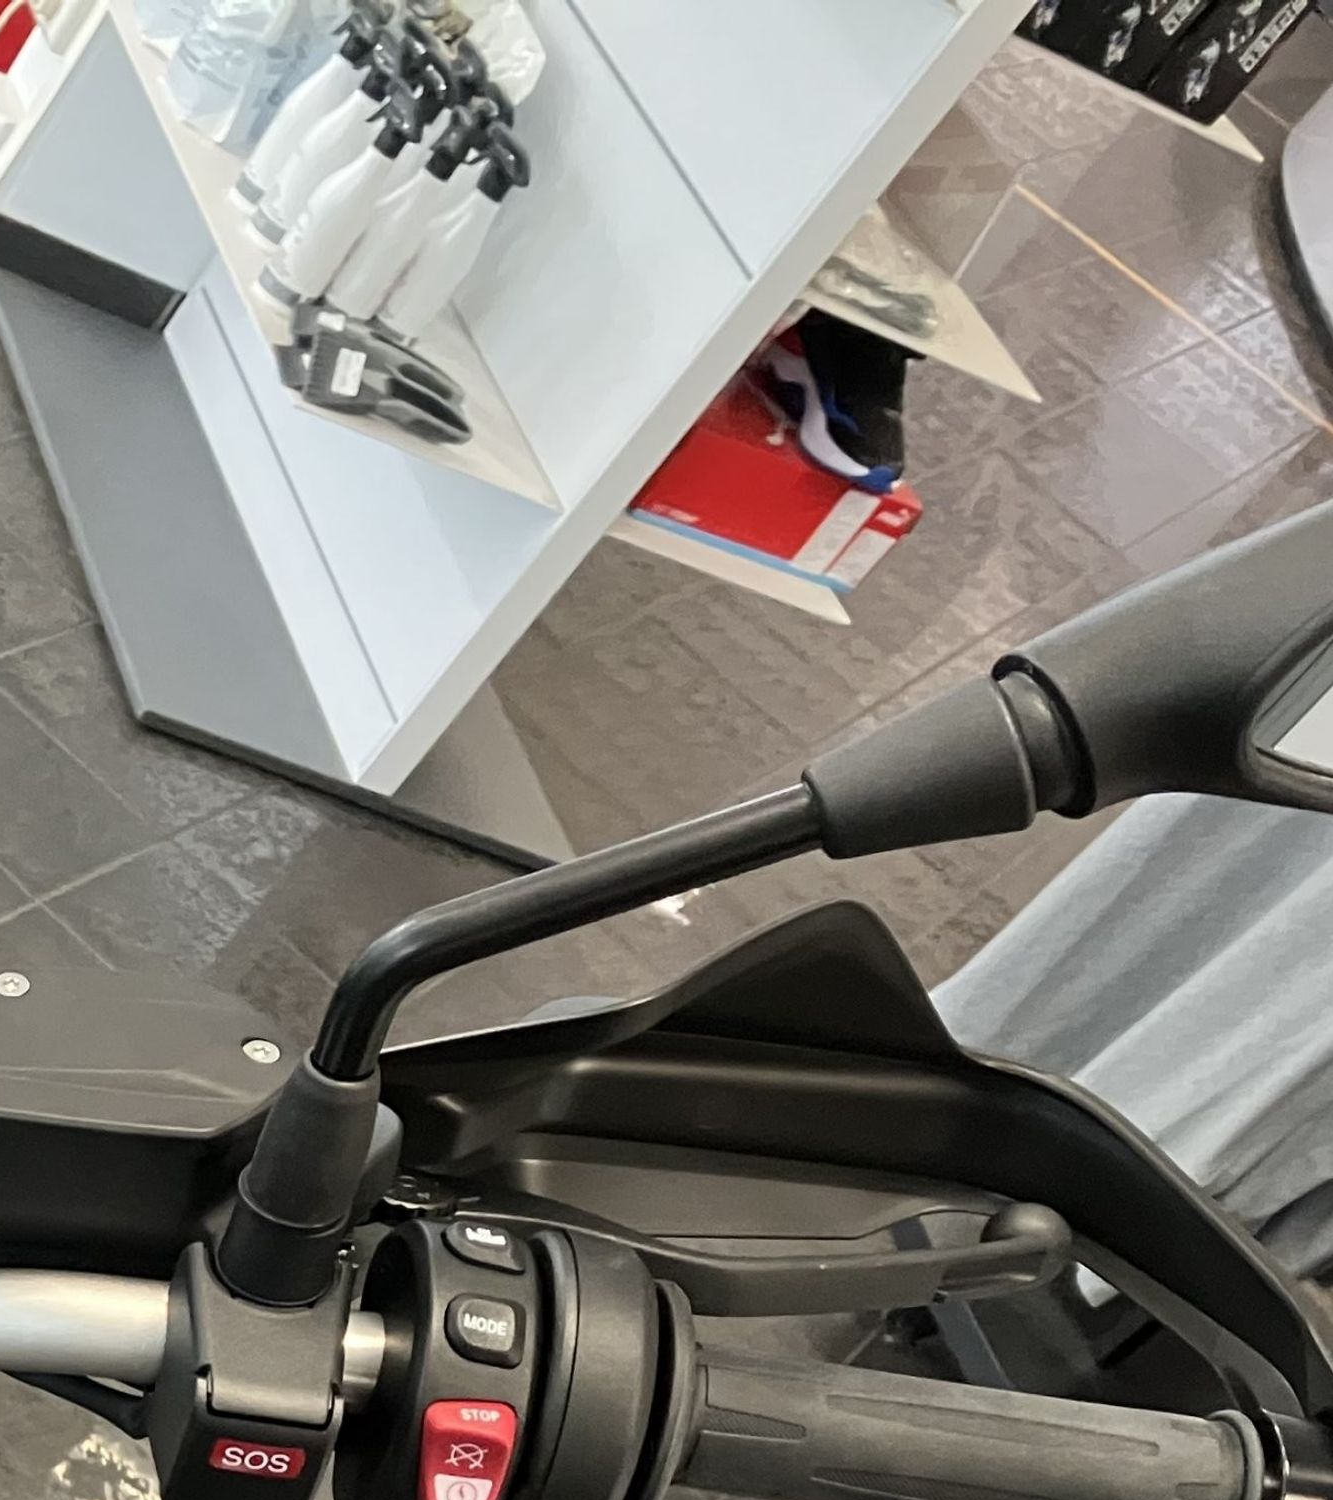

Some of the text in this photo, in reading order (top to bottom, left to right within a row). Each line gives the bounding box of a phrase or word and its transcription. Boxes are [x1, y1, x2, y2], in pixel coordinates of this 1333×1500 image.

[463, 1312, 508, 1336] MODE
[460, 1408, 501, 1424] STOP
[221, 1446, 291, 1473] SOS
